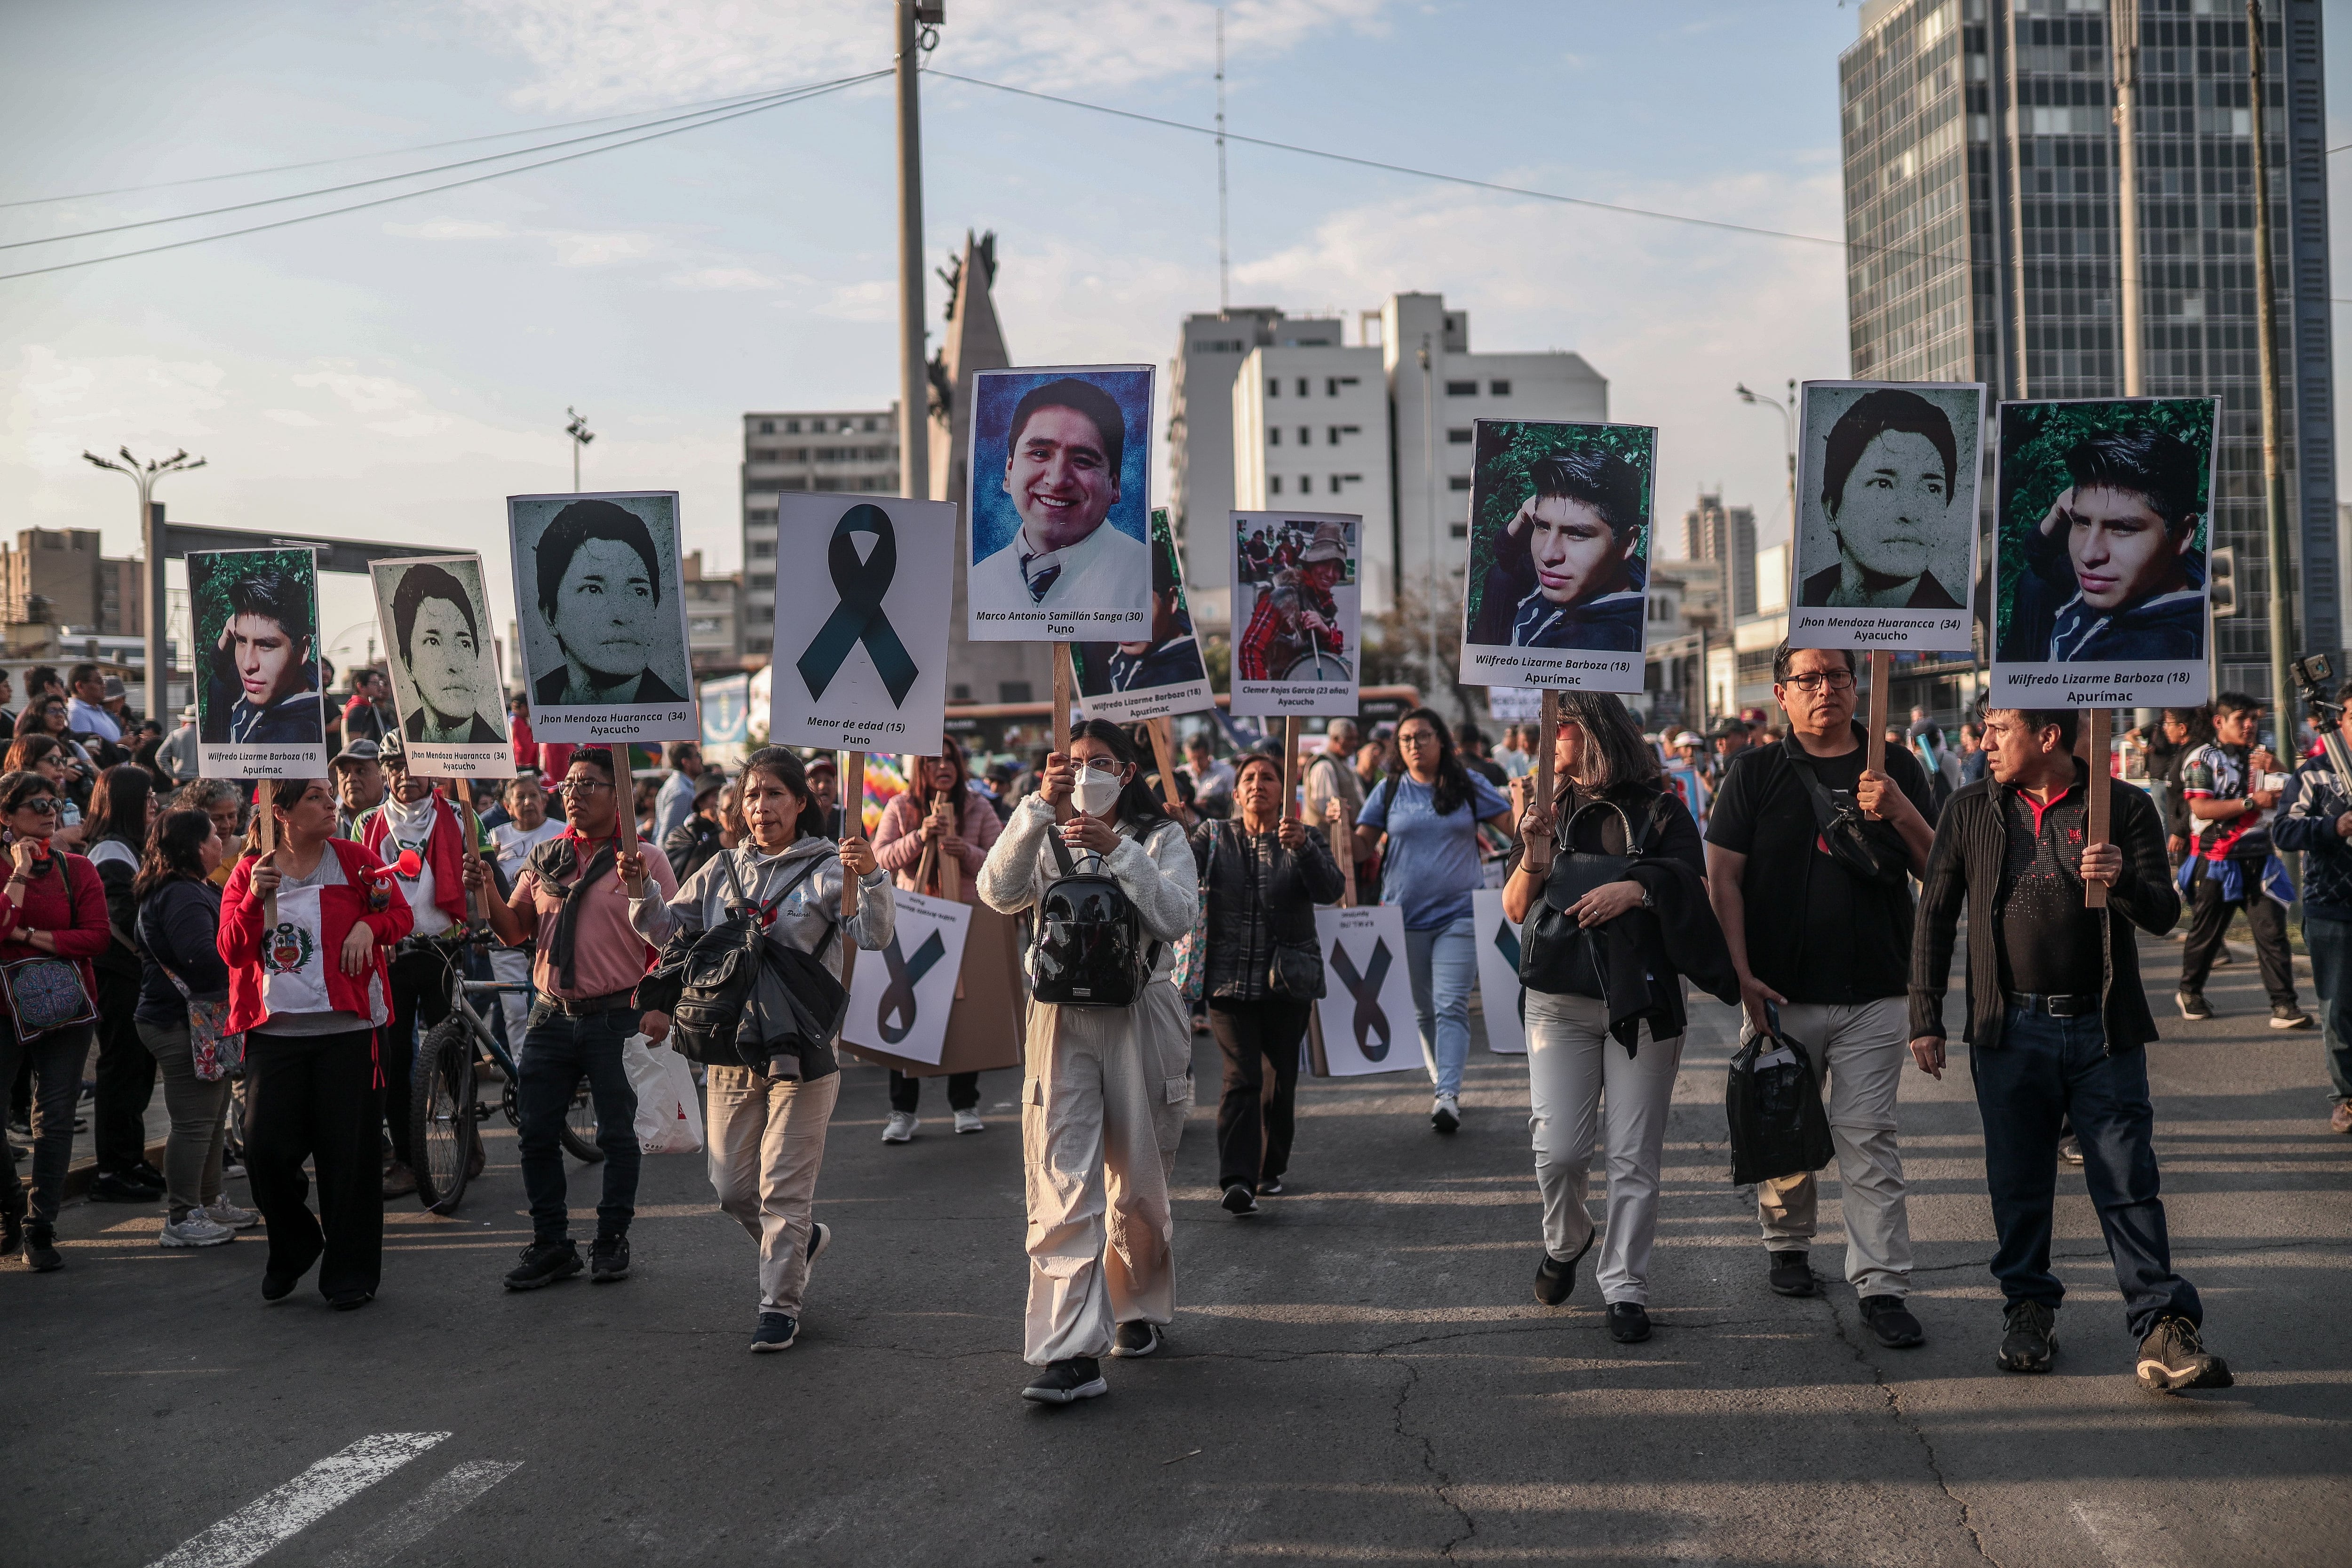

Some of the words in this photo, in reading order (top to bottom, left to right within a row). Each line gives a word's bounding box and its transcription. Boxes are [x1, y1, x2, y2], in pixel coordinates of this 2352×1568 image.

[976, 612, 1006, 620] Marco
[1008, 612, 1046, 620] Antonio
[1049, 612, 1090, 620] Samillán
[1093, 612, 1122, 623] Sanga
[1125, 612, 1144, 622] (30)
[1047, 624, 1074, 633] Puno
[1799, 617, 1824, 628] Jhon
[1828, 618, 1875, 627] Mendoza
[1877, 619, 1934, 628] Huarancca
[1940, 620, 1961, 630] (34)
[1854, 631, 1908, 642] Ayacucho
[1476, 655, 1518, 666] Wilfredo
[1522, 657, 1562, 668] Lizarme
[1565, 660, 1608, 670] Barboza
[1610, 662, 1630, 672] (18)
[1525, 673, 1581, 685] Apurímac
[2008, 674, 2058, 687] Wilfredo
[2062, 675, 2110, 684] Lizarme
[2114, 673, 2164, 683] Barboza
[2167, 672, 2190, 684] (18)
[1271, 686, 1290, 695] Rojas
[1092, 700, 1122, 711] Wilfredo
[1124, 697, 1153, 706] Lizarme
[1155, 692, 1185, 701] Barboza
[1187, 688, 1201, 697] (18)
[1278, 698, 1314, 707] Ayacucho
[2067, 691, 2133, 705] Apurímac
[539, 715, 561, 724] Jhon
[564, 714, 607, 723] Mendoza
[610, 713, 662, 722] Huarancca
[668, 712, 686, 722] (34)
[807, 716, 840, 727] Menor
[843, 720, 855, 728] de
[858, 721, 884, 731] edad
[886, 723, 906, 733] (15)
[590, 725, 640, 736] Ayacucho
[843, 734, 870, 744] Puno
[208, 753, 237, 762] Wilfredo
[302, 753, 316, 761] (18)
[412, 751, 424, 759] Jhon
[494, 752, 507, 761] (34)
[243, 766, 282, 775] Apurímac
[444, 762, 476, 771] Ayacucho
